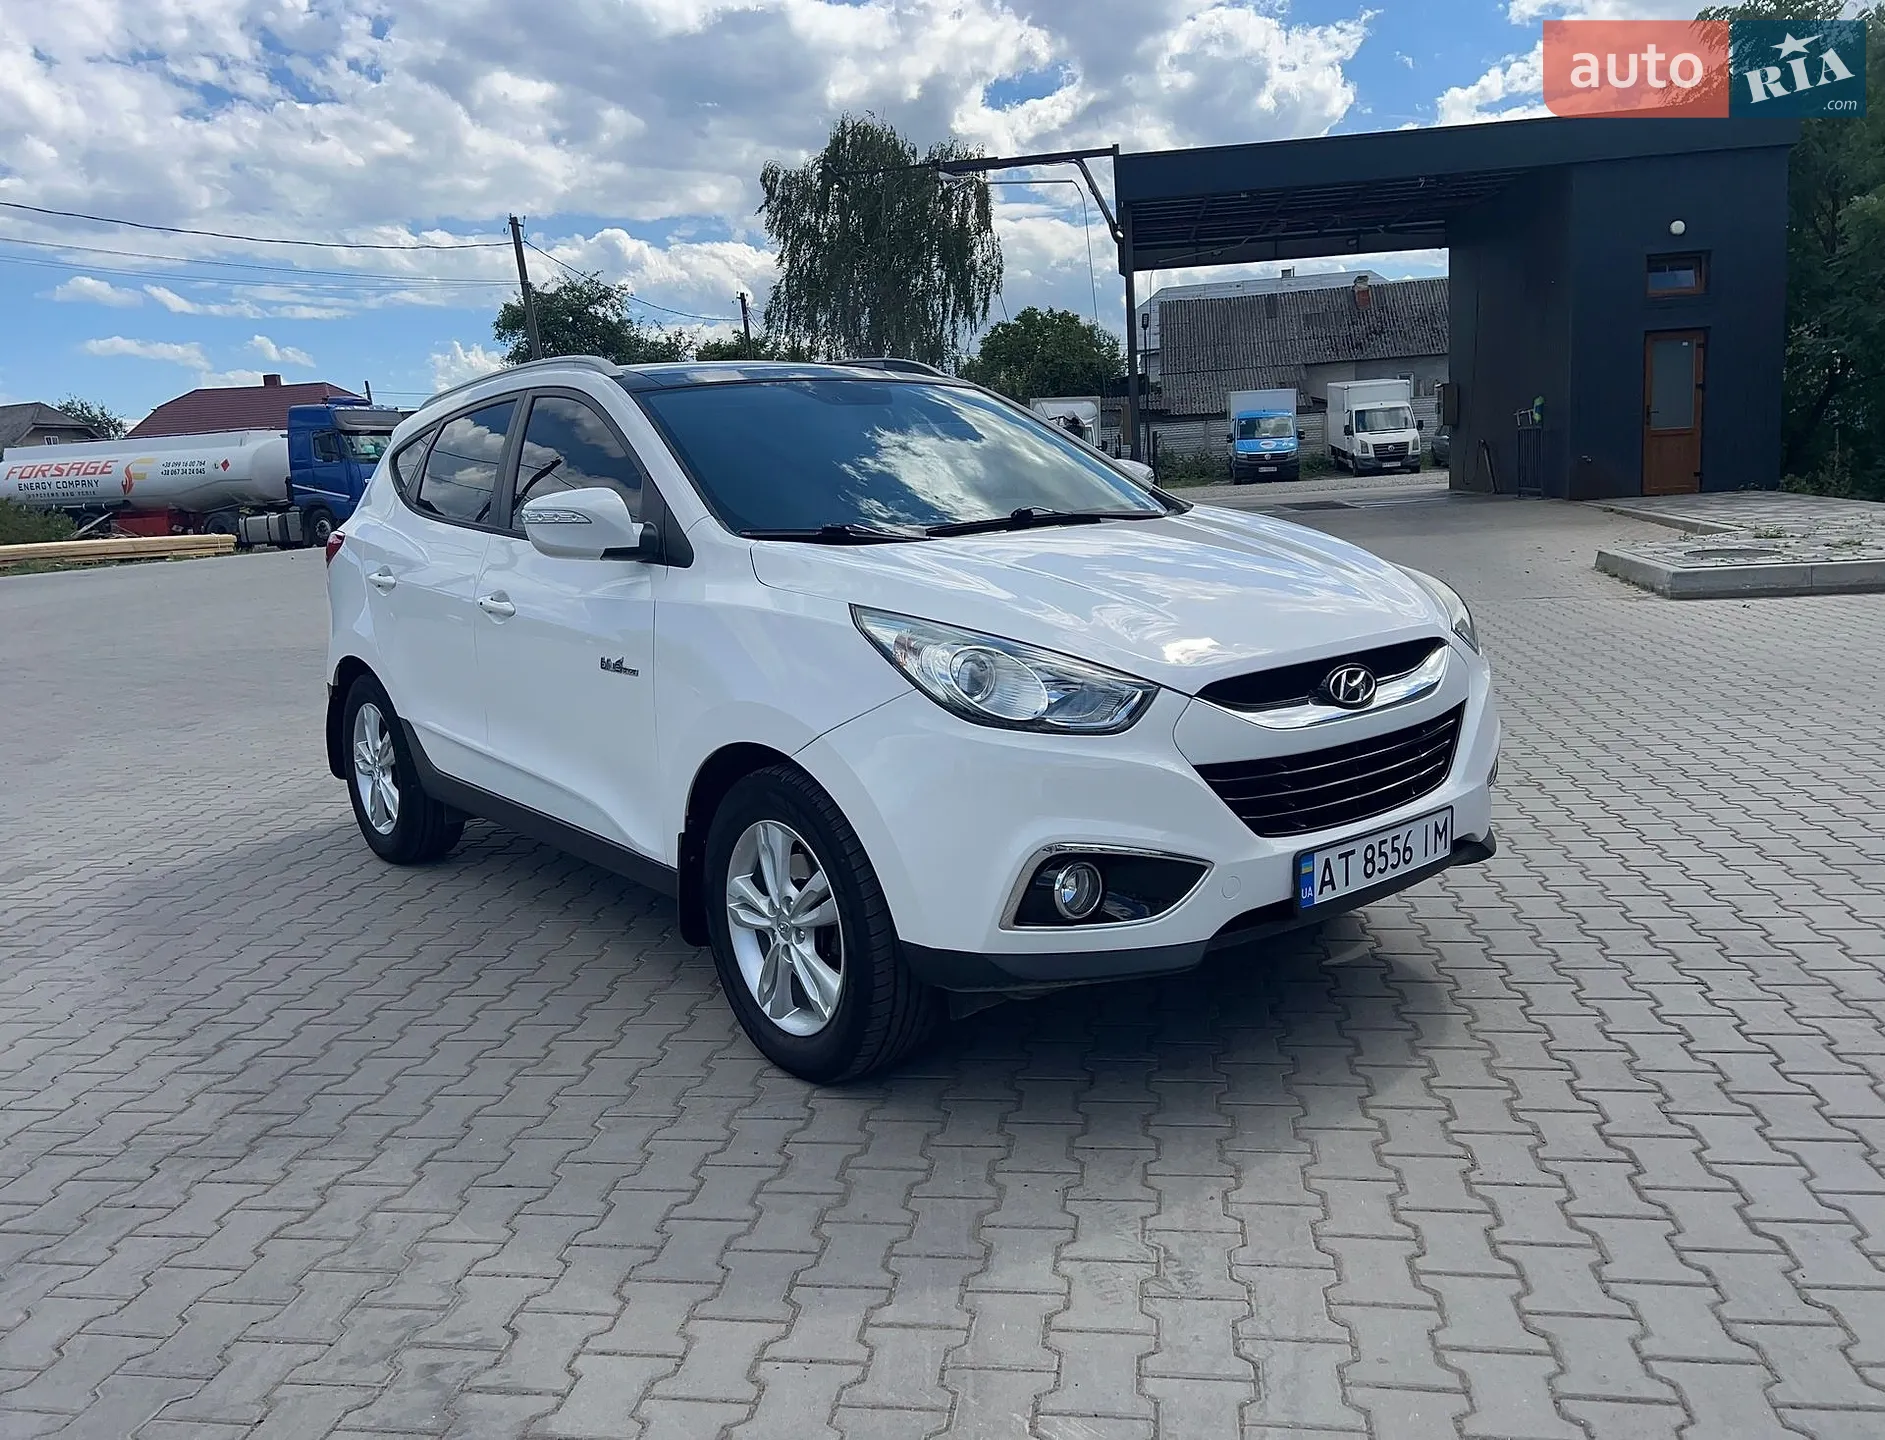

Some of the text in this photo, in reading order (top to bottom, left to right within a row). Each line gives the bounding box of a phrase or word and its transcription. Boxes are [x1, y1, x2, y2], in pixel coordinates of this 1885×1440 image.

[4, 460, 119, 480] FORSAGE
[18, 479, 99, 491] ENERGY COMPANY
[1318, 816, 1448, 895] AT 8556 IM
[1301, 886, 1313, 899] UA
